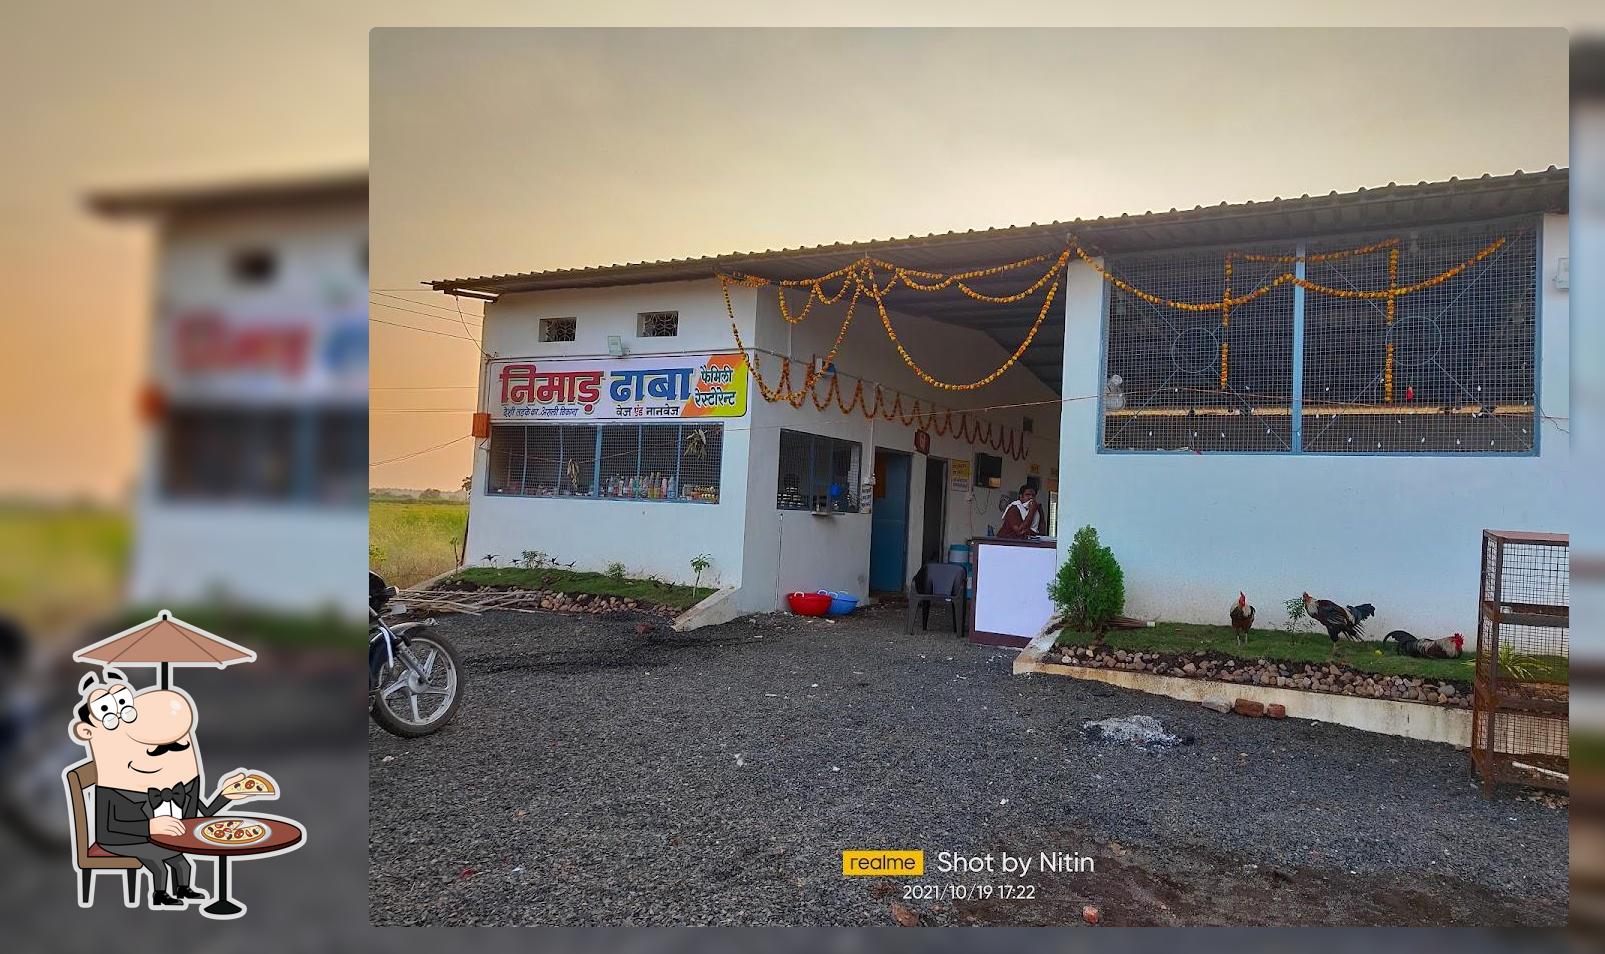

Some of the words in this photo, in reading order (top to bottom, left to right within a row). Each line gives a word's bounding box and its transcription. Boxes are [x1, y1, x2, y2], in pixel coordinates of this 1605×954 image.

[700, 364, 734, 384] फैमिली
[499, 364, 605, 414] निमाड़
[610, 367, 694, 403] ढाबा
[616, 404, 632, 416] वेज
